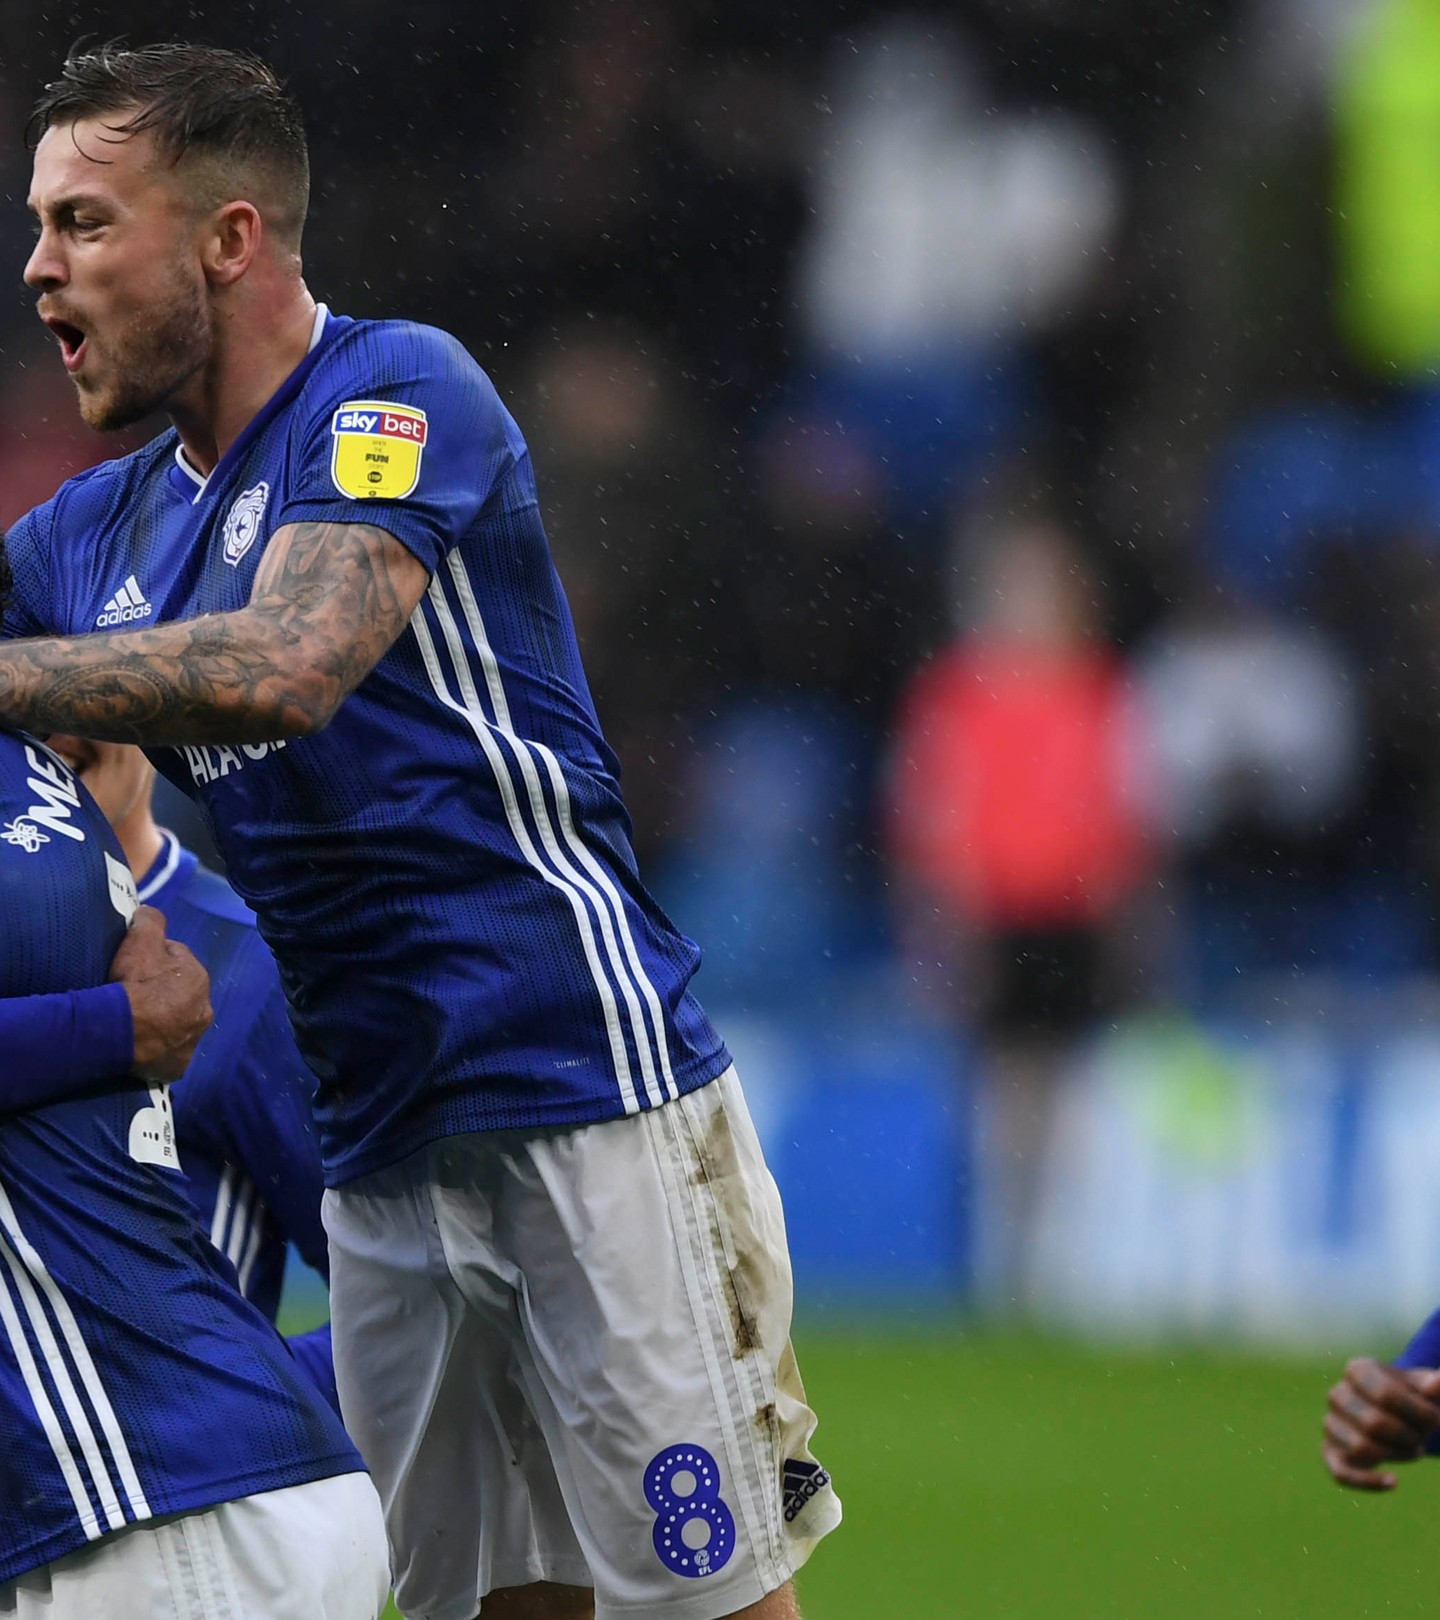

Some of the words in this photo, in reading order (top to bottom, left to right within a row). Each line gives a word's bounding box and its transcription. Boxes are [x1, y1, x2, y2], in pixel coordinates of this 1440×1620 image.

[340, 411, 378, 432] sky
[384, 414, 421, 438] bet
[365, 453, 389, 464] FUN
[96, 602, 152, 627] adidas
[23, 738, 85, 842] ME
[643, 1443, 736, 1578] 8
[698, 1565, 713, 1576] EFL
